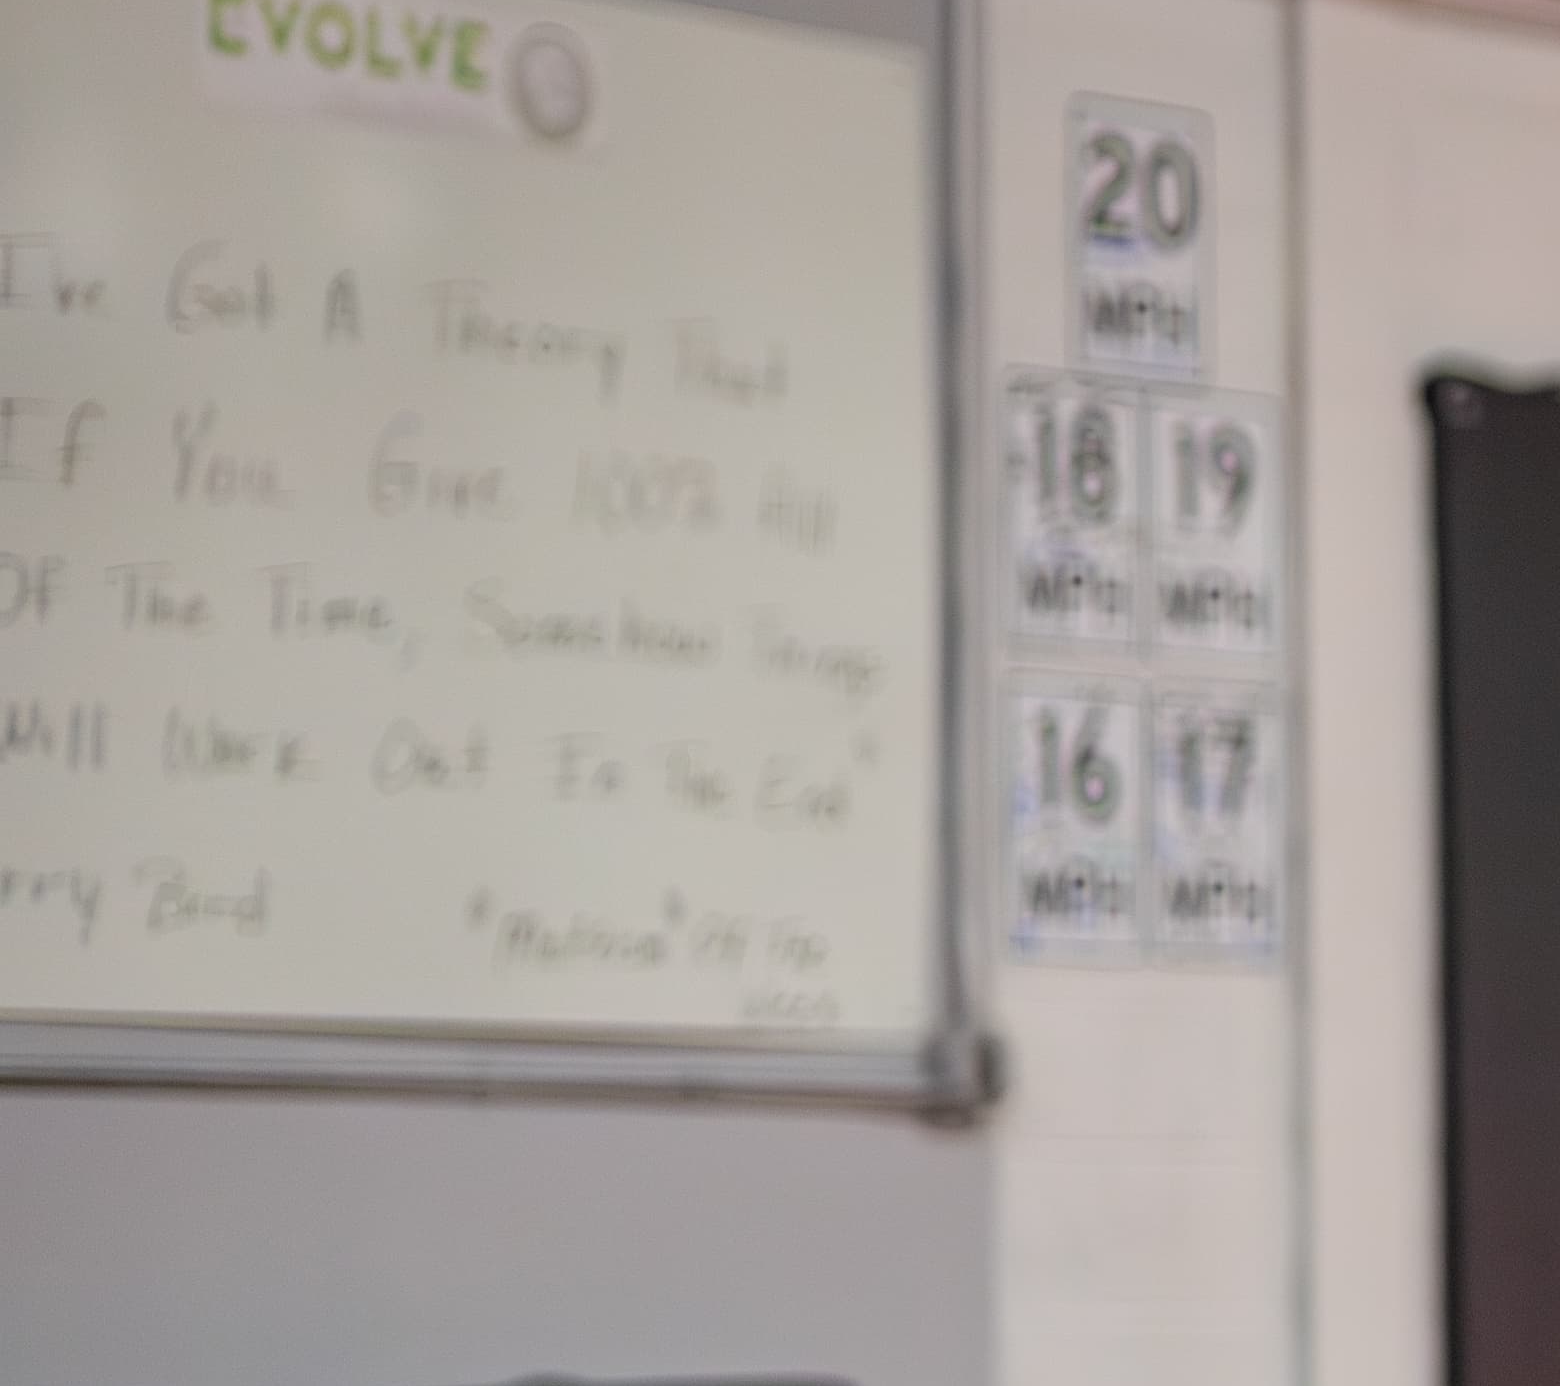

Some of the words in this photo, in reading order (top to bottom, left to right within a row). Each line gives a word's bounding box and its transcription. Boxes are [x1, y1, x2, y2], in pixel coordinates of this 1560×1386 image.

[1088, 128, 1202, 253] 20
[322, 266, 364, 349] A
[1036, 703, 1122, 829] 16
